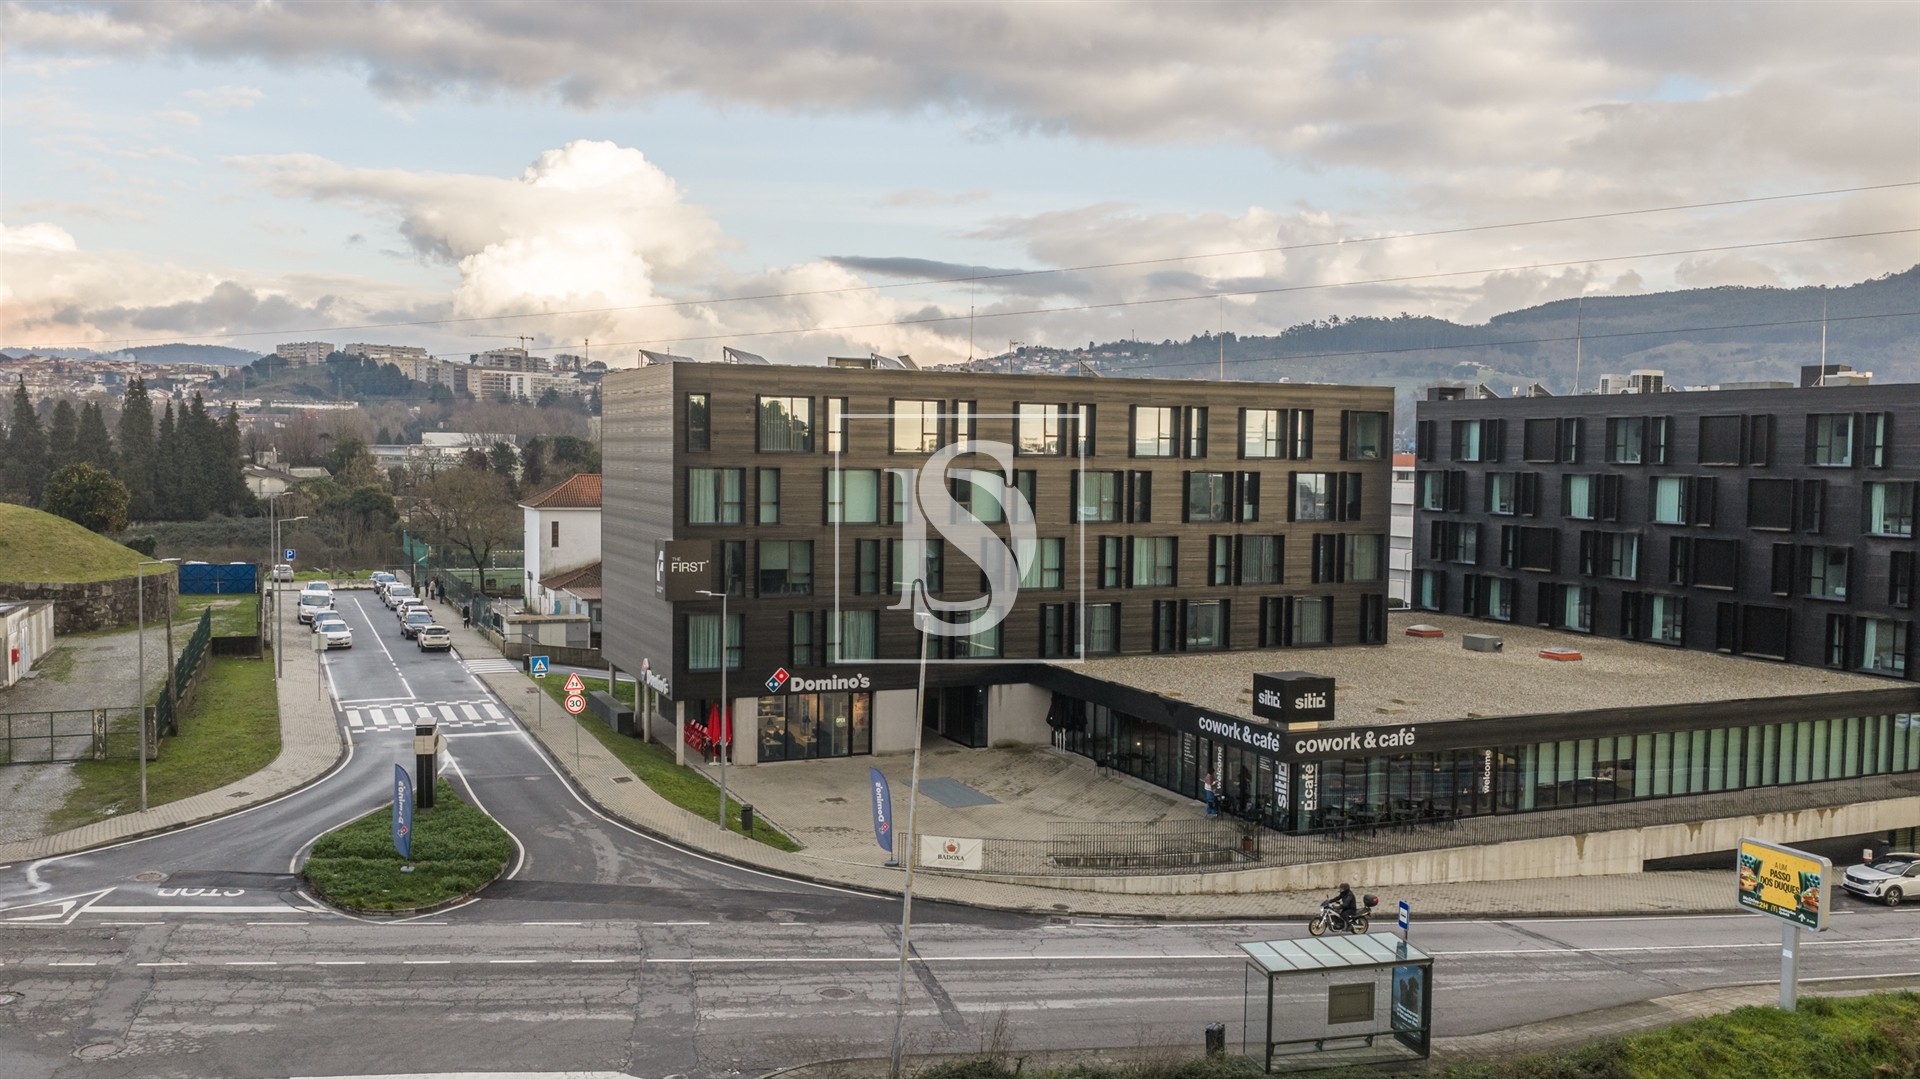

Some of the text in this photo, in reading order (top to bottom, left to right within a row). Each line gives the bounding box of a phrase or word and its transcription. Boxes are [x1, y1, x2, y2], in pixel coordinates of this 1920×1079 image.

[671, 561, 706, 573] FIRST
[790, 673, 871, 692] Domino's
[569, 699, 582, 708] 30
[1198, 717, 1241, 741] cowork
[1242, 725, 1252, 744] &
[1295, 732, 1361, 754] cowork
[1363, 730, 1377, 749] &
[1482, 749, 1492, 794] welcome
[1769, 868, 1791, 882] PASSO
[1760, 875, 1800, 895] DOS DUQUES
